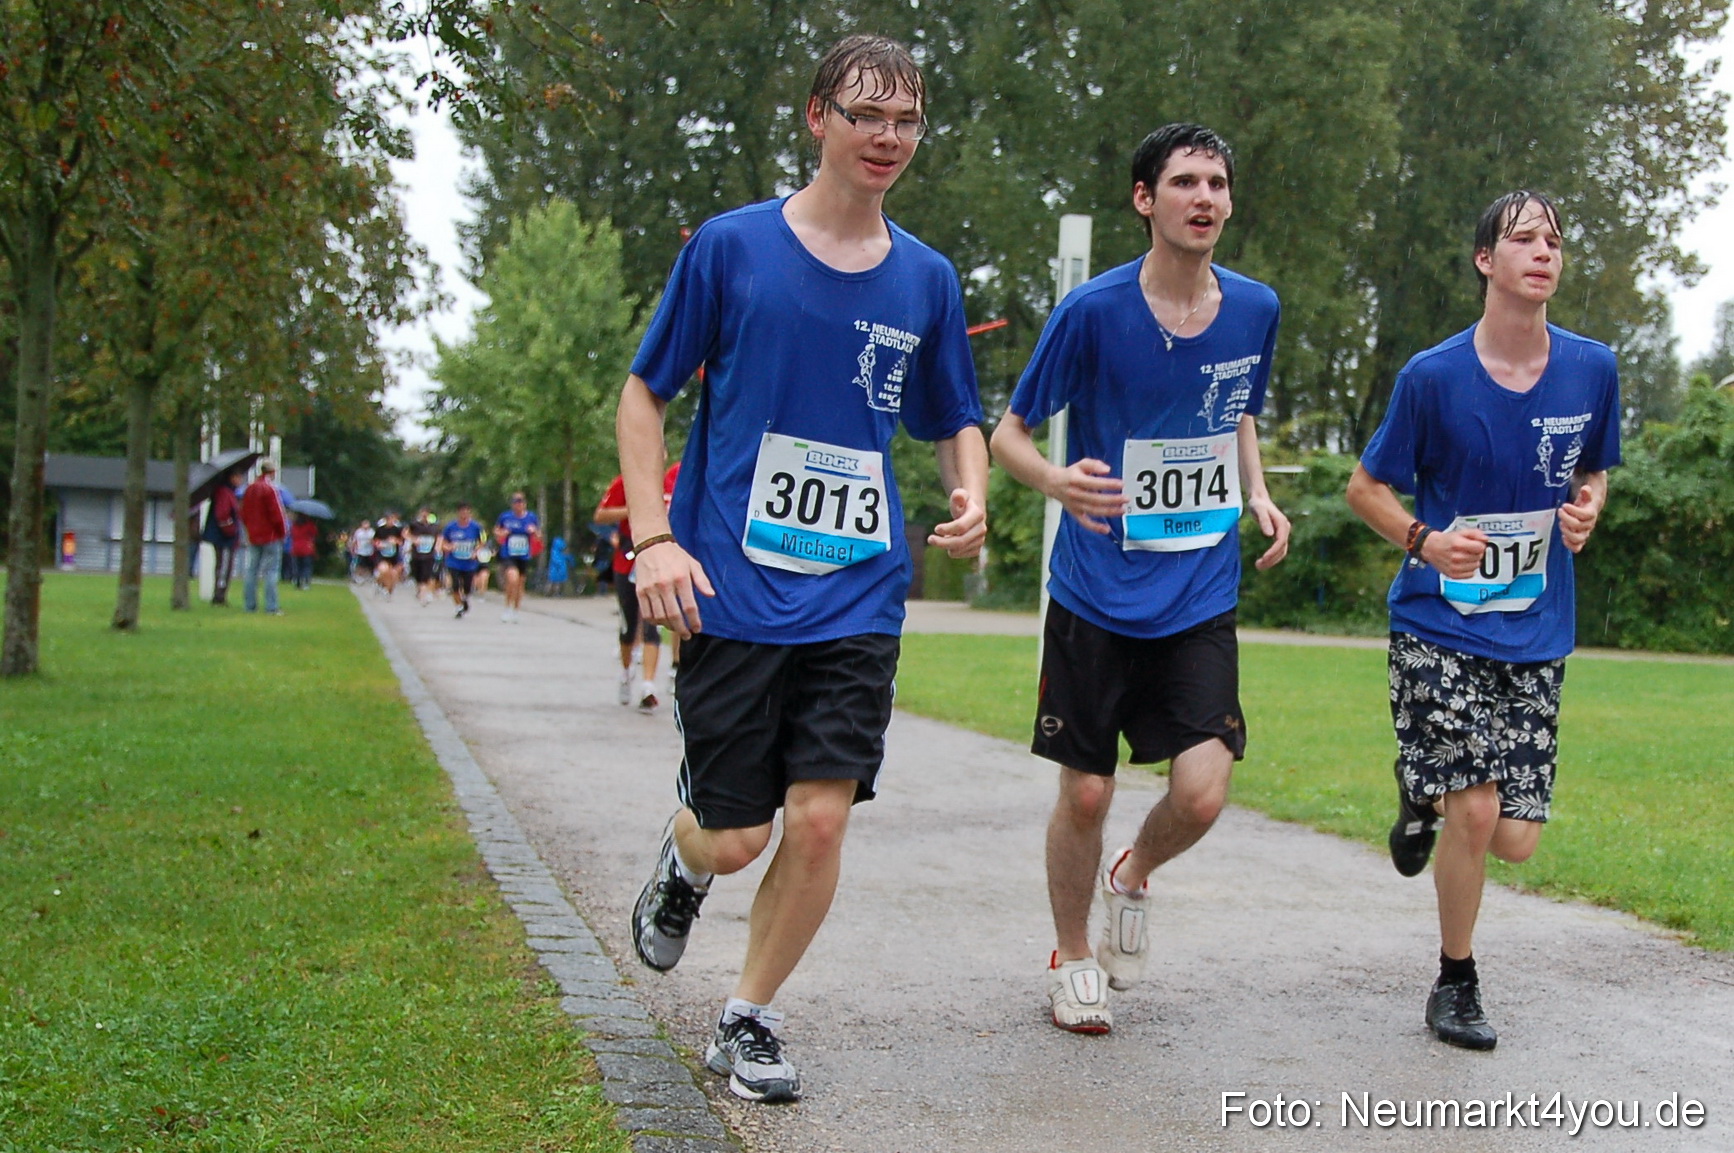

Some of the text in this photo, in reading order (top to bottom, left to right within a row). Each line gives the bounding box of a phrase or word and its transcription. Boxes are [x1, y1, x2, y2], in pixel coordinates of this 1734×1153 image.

[853, 319, 871, 332] 12.
[1200, 364, 1215, 374] 12.
[1163, 444, 1208, 458] BOCK
[806, 450, 859, 471] BOCK
[1135, 464, 1228, 510] 3014
[765, 471, 880, 535] 3013
[754, 510, 760, 518] D
[1163, 518, 1203, 535] Rene
[1477, 520, 1523, 531] BOCK
[780, 532, 855, 562] Michael
[1480, 538, 1543, 580] 015
